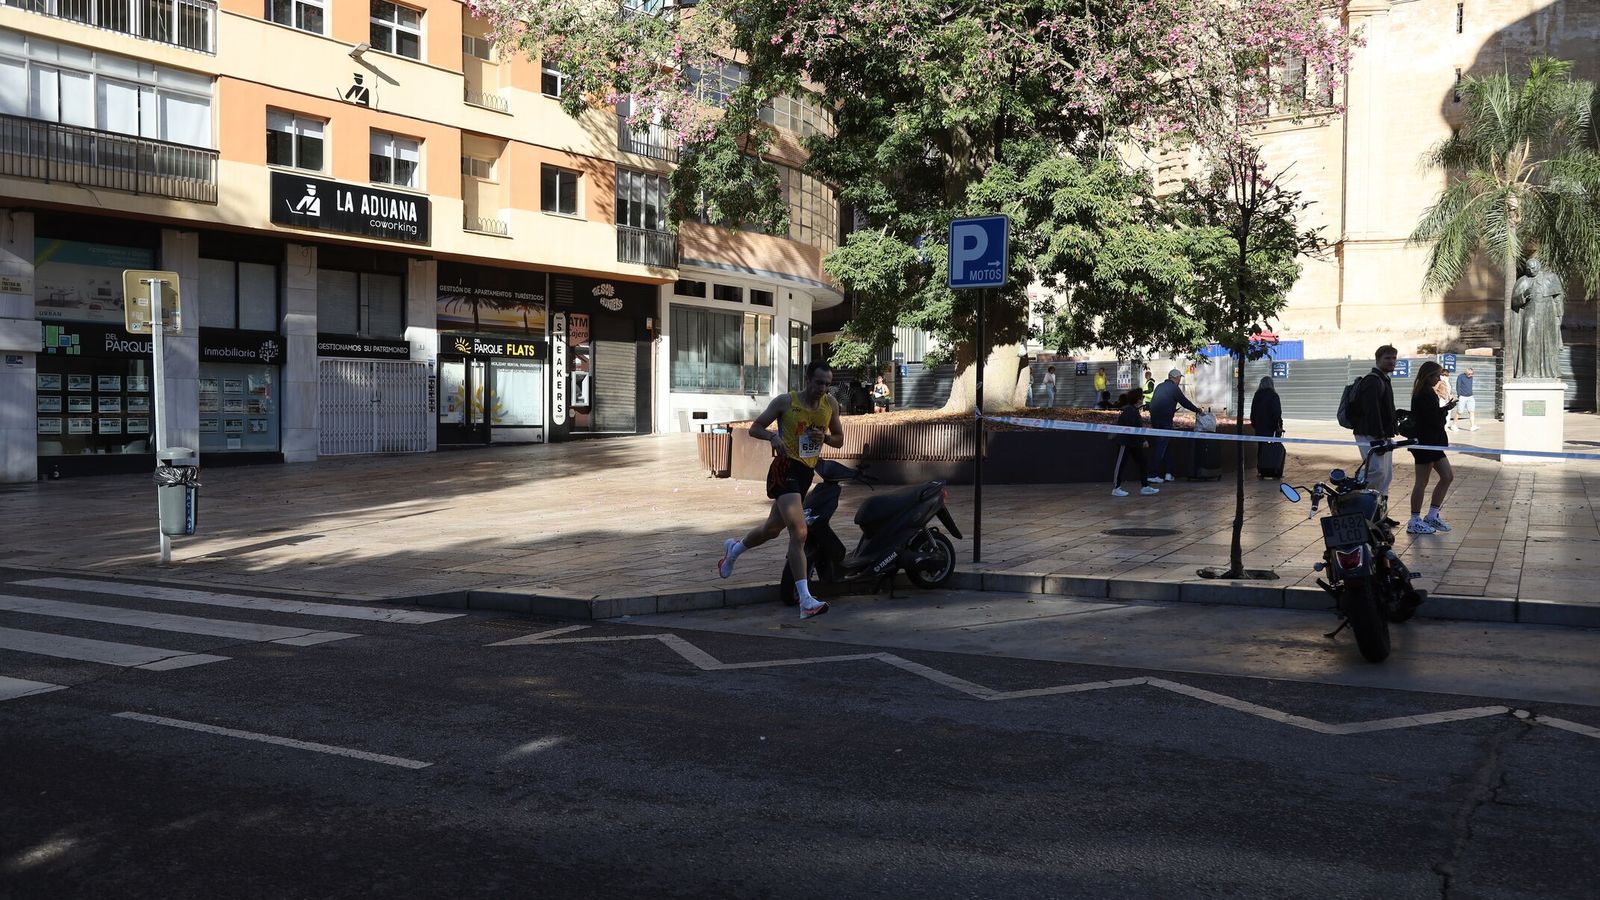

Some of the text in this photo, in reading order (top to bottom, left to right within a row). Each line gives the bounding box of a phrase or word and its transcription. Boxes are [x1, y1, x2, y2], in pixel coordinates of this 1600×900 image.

[336, 190, 418, 222] LA ADUANA
[370, 219, 417, 235] coworking
[952, 224, 988, 280] P
[970, 268, 1002, 280] MOTOS
[474, 288, 512, 298] APARTAMENTOS
[570, 317, 588, 327] ATM
[105, 340, 256, 358] PARQUE inmobiliaria
[318, 343, 362, 352] GESTIONAMOS
[474, 344, 534, 356] PARQUE FLATS
